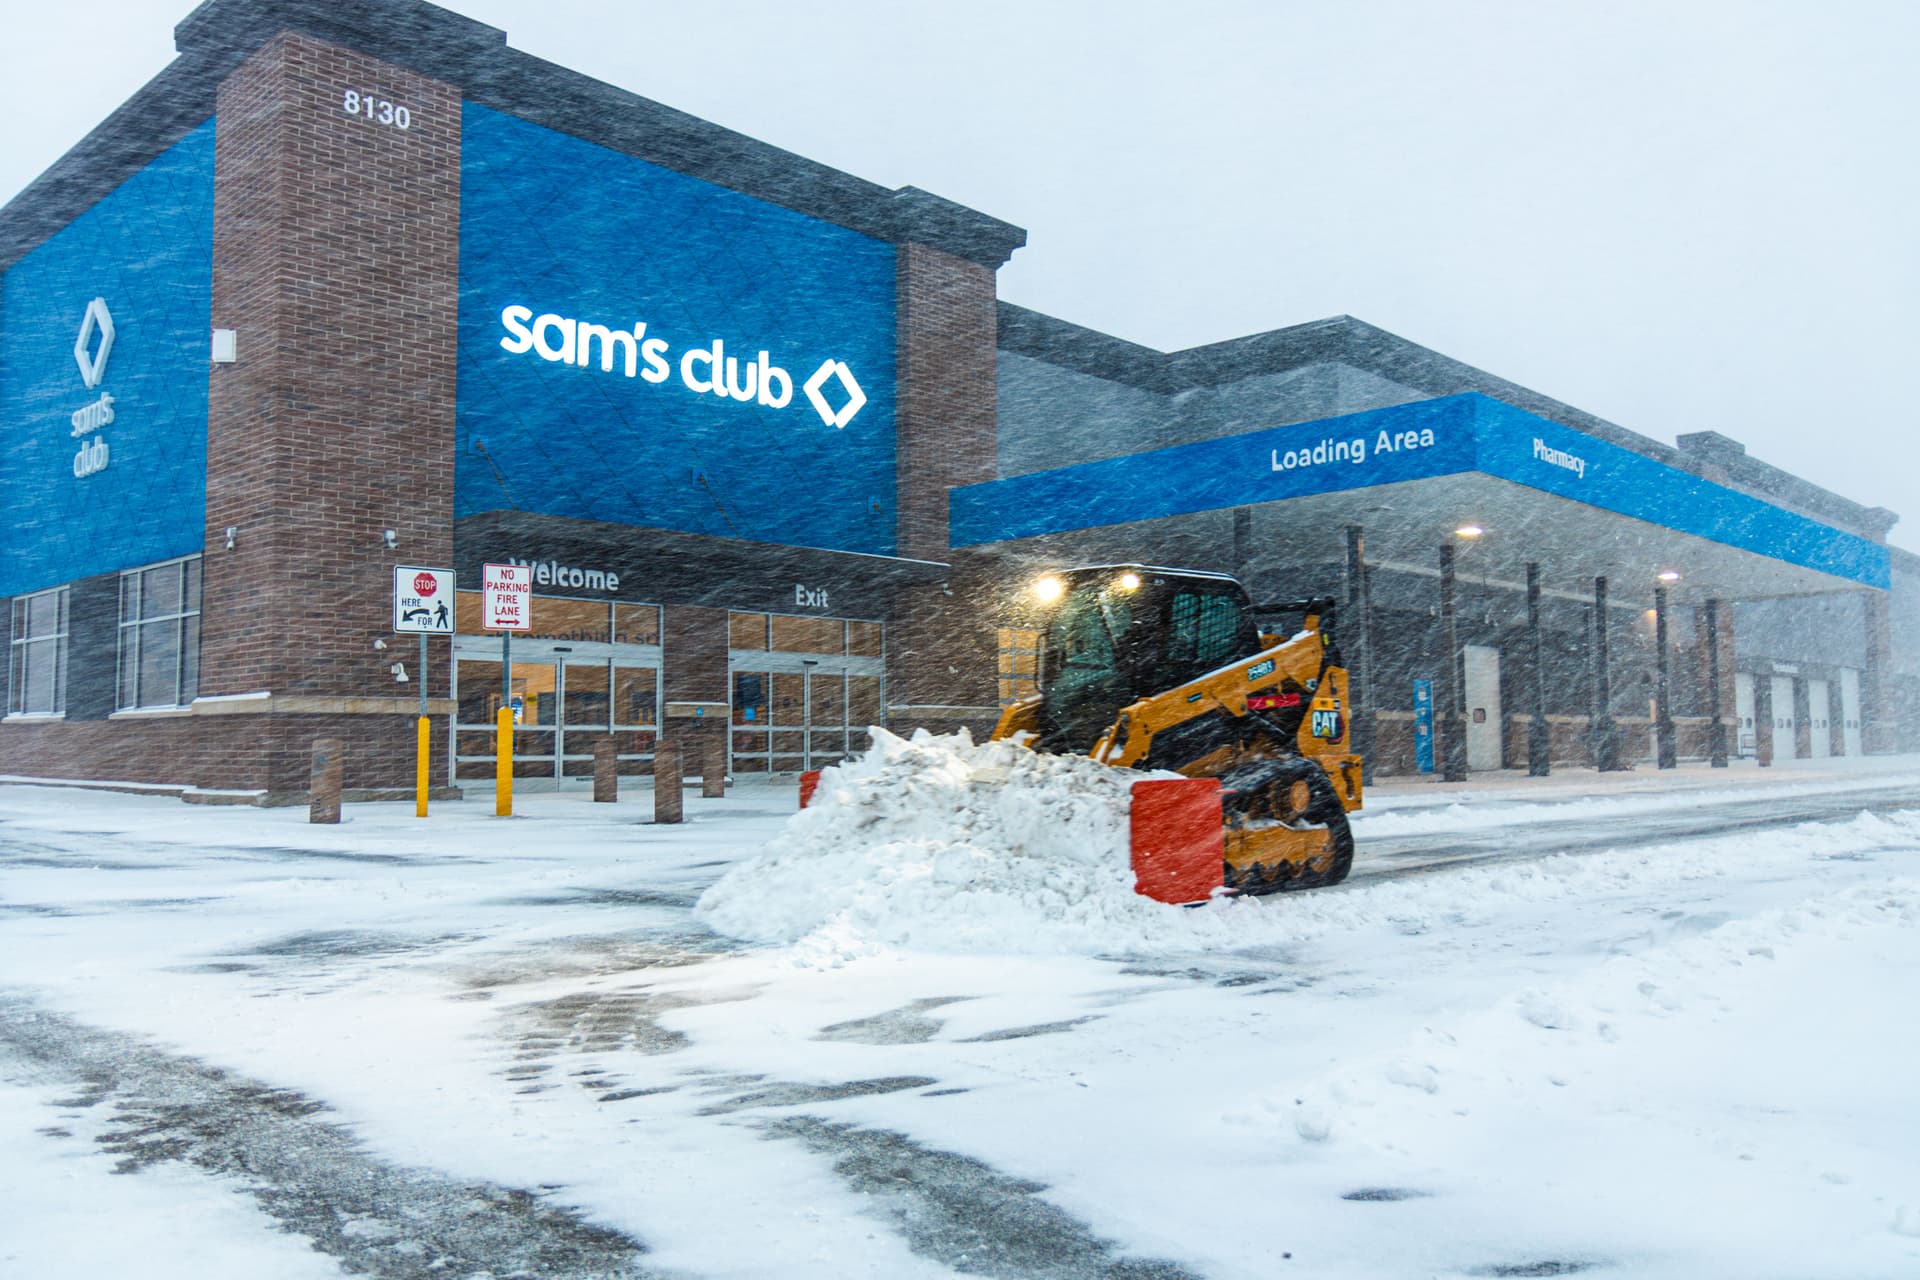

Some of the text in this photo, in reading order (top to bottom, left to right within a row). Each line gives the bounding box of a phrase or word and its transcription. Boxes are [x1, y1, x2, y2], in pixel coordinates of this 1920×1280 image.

[343, 89, 411, 130] 8130
[499, 305, 794, 409] sam's club
[70, 391, 115, 438] sam's
[74, 435, 110, 478] club
[1271, 428, 1435, 472] Loading Area
[1533, 437, 1584, 479] Pharmacy
[414, 579, 436, 591] STOP
[486, 581, 529, 593] PARKING
[500, 569, 515, 580] NO
[401, 598, 422, 607] HERE
[497, 594, 518, 605] FIRE
[795, 583, 829, 608] Exit
[417, 616, 433, 626] FOR
[494, 606, 520, 617] LANE
[1312, 711, 1339, 738] CAT
